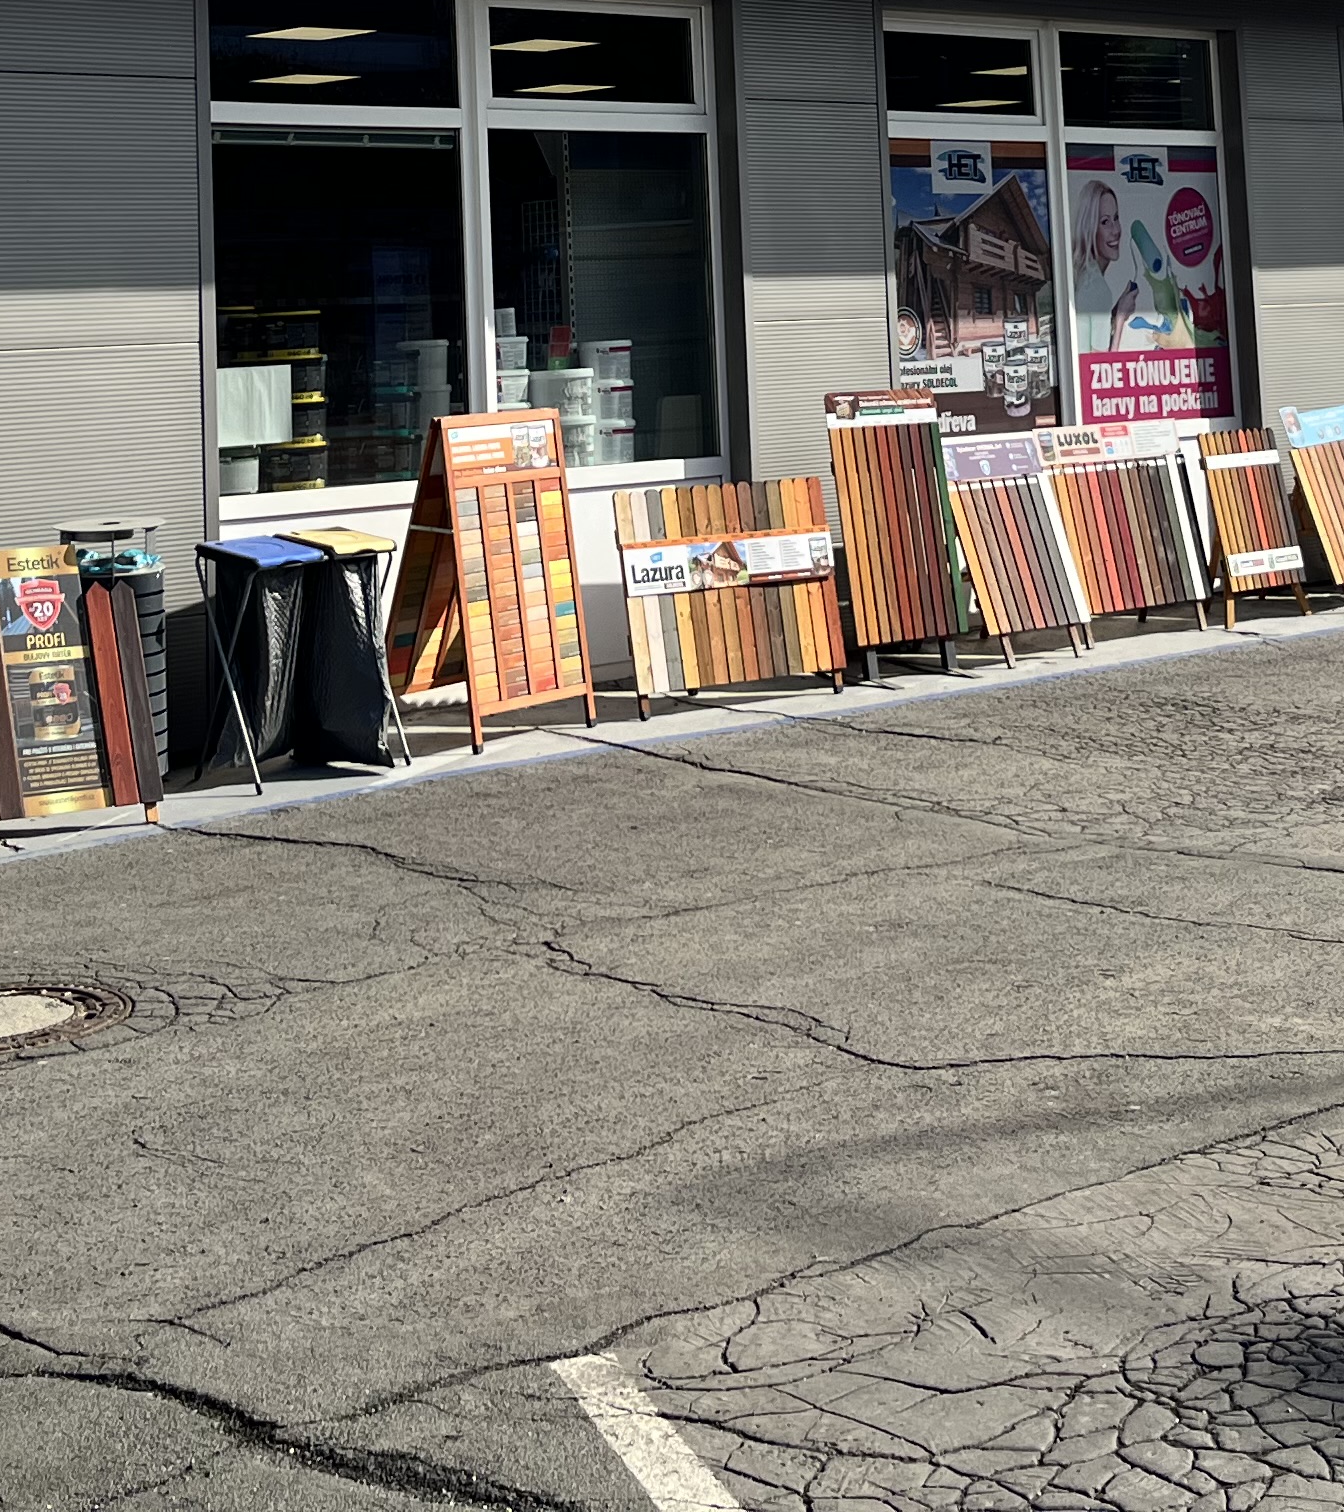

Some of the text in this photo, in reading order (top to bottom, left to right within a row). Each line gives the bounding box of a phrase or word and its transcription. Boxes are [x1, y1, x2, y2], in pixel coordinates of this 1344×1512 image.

[947, 153, 982, 177] HET
[1129, 157, 1160, 180] HET
[1168, 202, 1205, 226] TÓNOVACÍ
[1170, 216, 1208, 238] CENTRUM
[1090, 354, 1216, 389] ZDE TÓNUJEME
[1091, 386, 1219, 420] barvy na počkání
[1056, 432, 1099, 447] LUXOL
[6, 553, 60, 572] Estetik
[631, 562, 686, 585] Lazura
[33, 600, 54, 618] 20
[26, 632, 66, 650] PROFI
